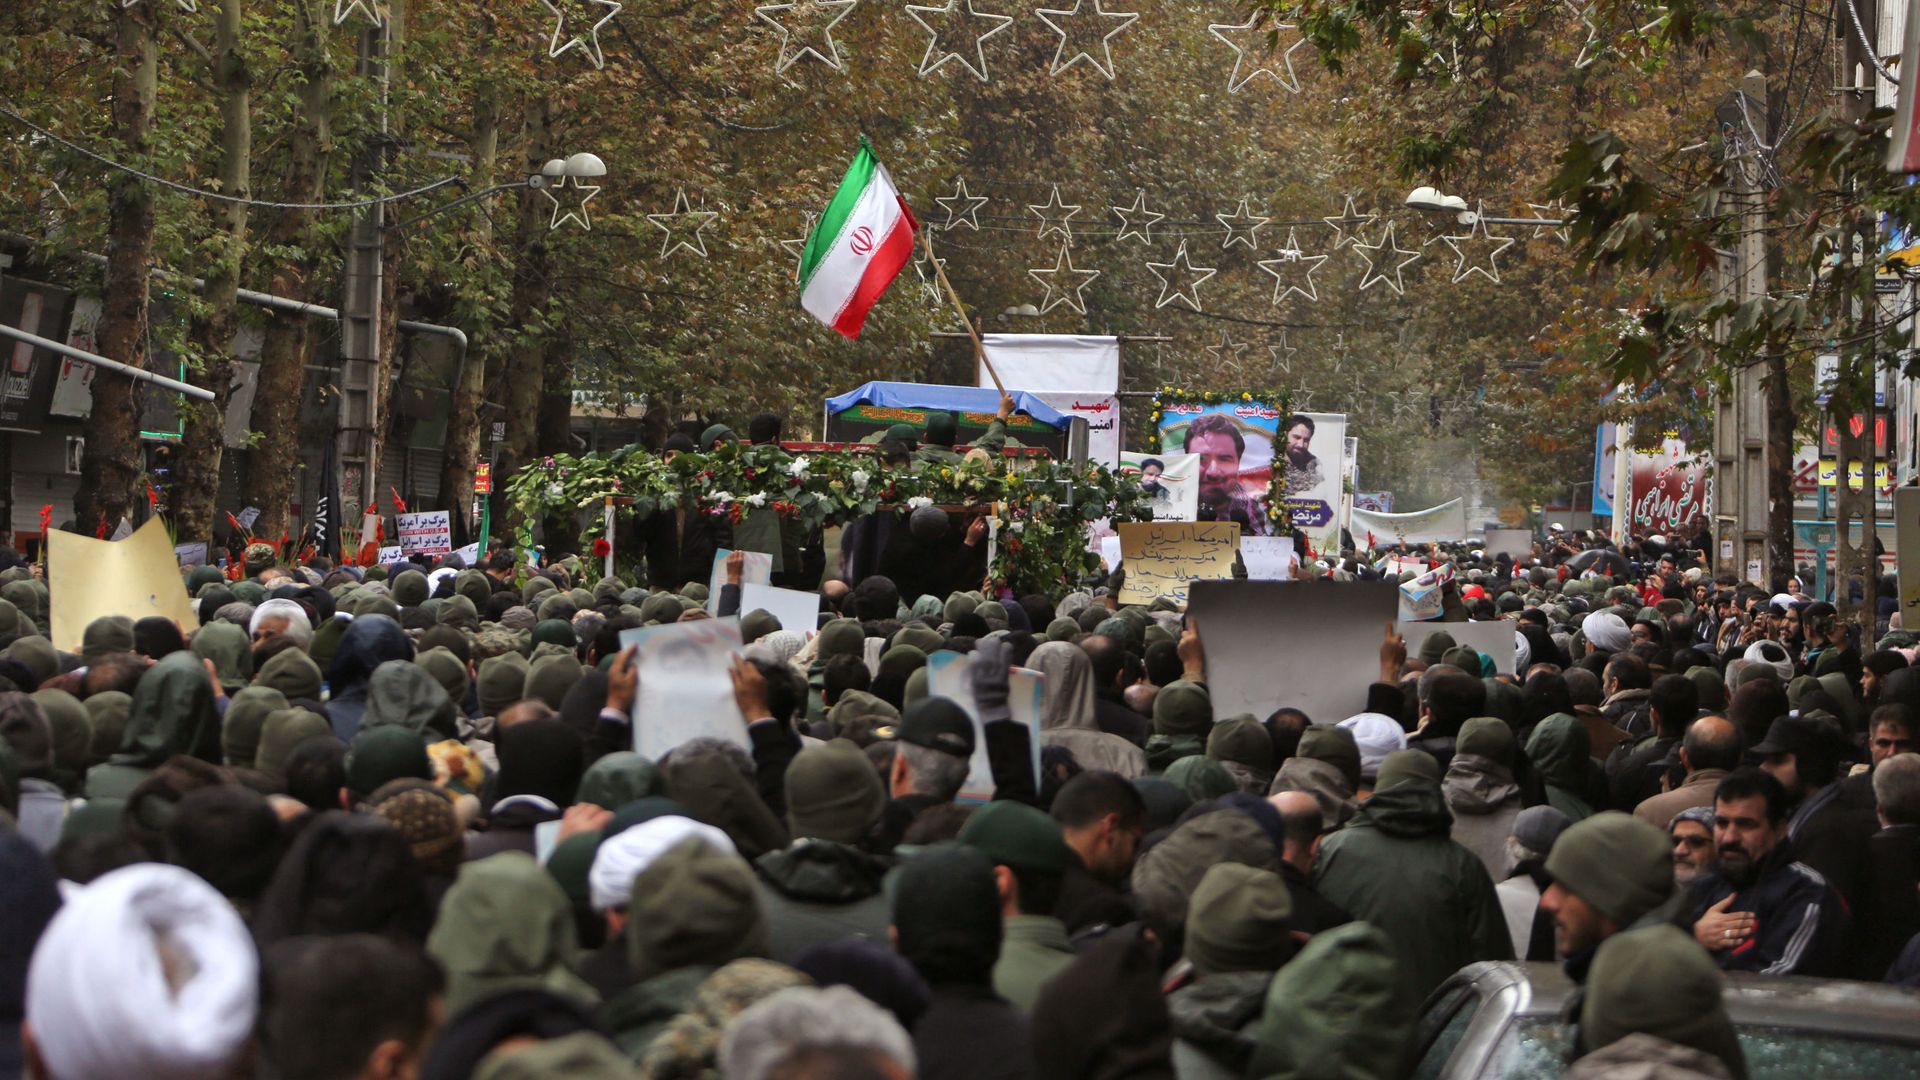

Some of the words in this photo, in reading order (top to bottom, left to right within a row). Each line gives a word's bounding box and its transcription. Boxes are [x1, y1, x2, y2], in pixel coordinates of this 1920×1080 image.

[1071, 399, 1110, 413] شهید
[1235, 405, 1259, 418] امنیت
[1089, 417, 1114, 434] امنی
[1668, 473, 1699, 527] مرتضی
[1634, 487, 1671, 531] ابراهیمی
[398, 514, 419, 530] آمریکا
[420, 518, 428, 528] بر
[428, 515, 447, 527] مرگ
[1153, 513, 1169, 521] امنی
[1169, 513, 1184, 521] شهید
[401, 535, 422, 548] اسرائیل
[424, 538, 431, 547] بر
[432, 535, 449, 547] مرگ
[1190, 548, 1220, 564] مرگ
